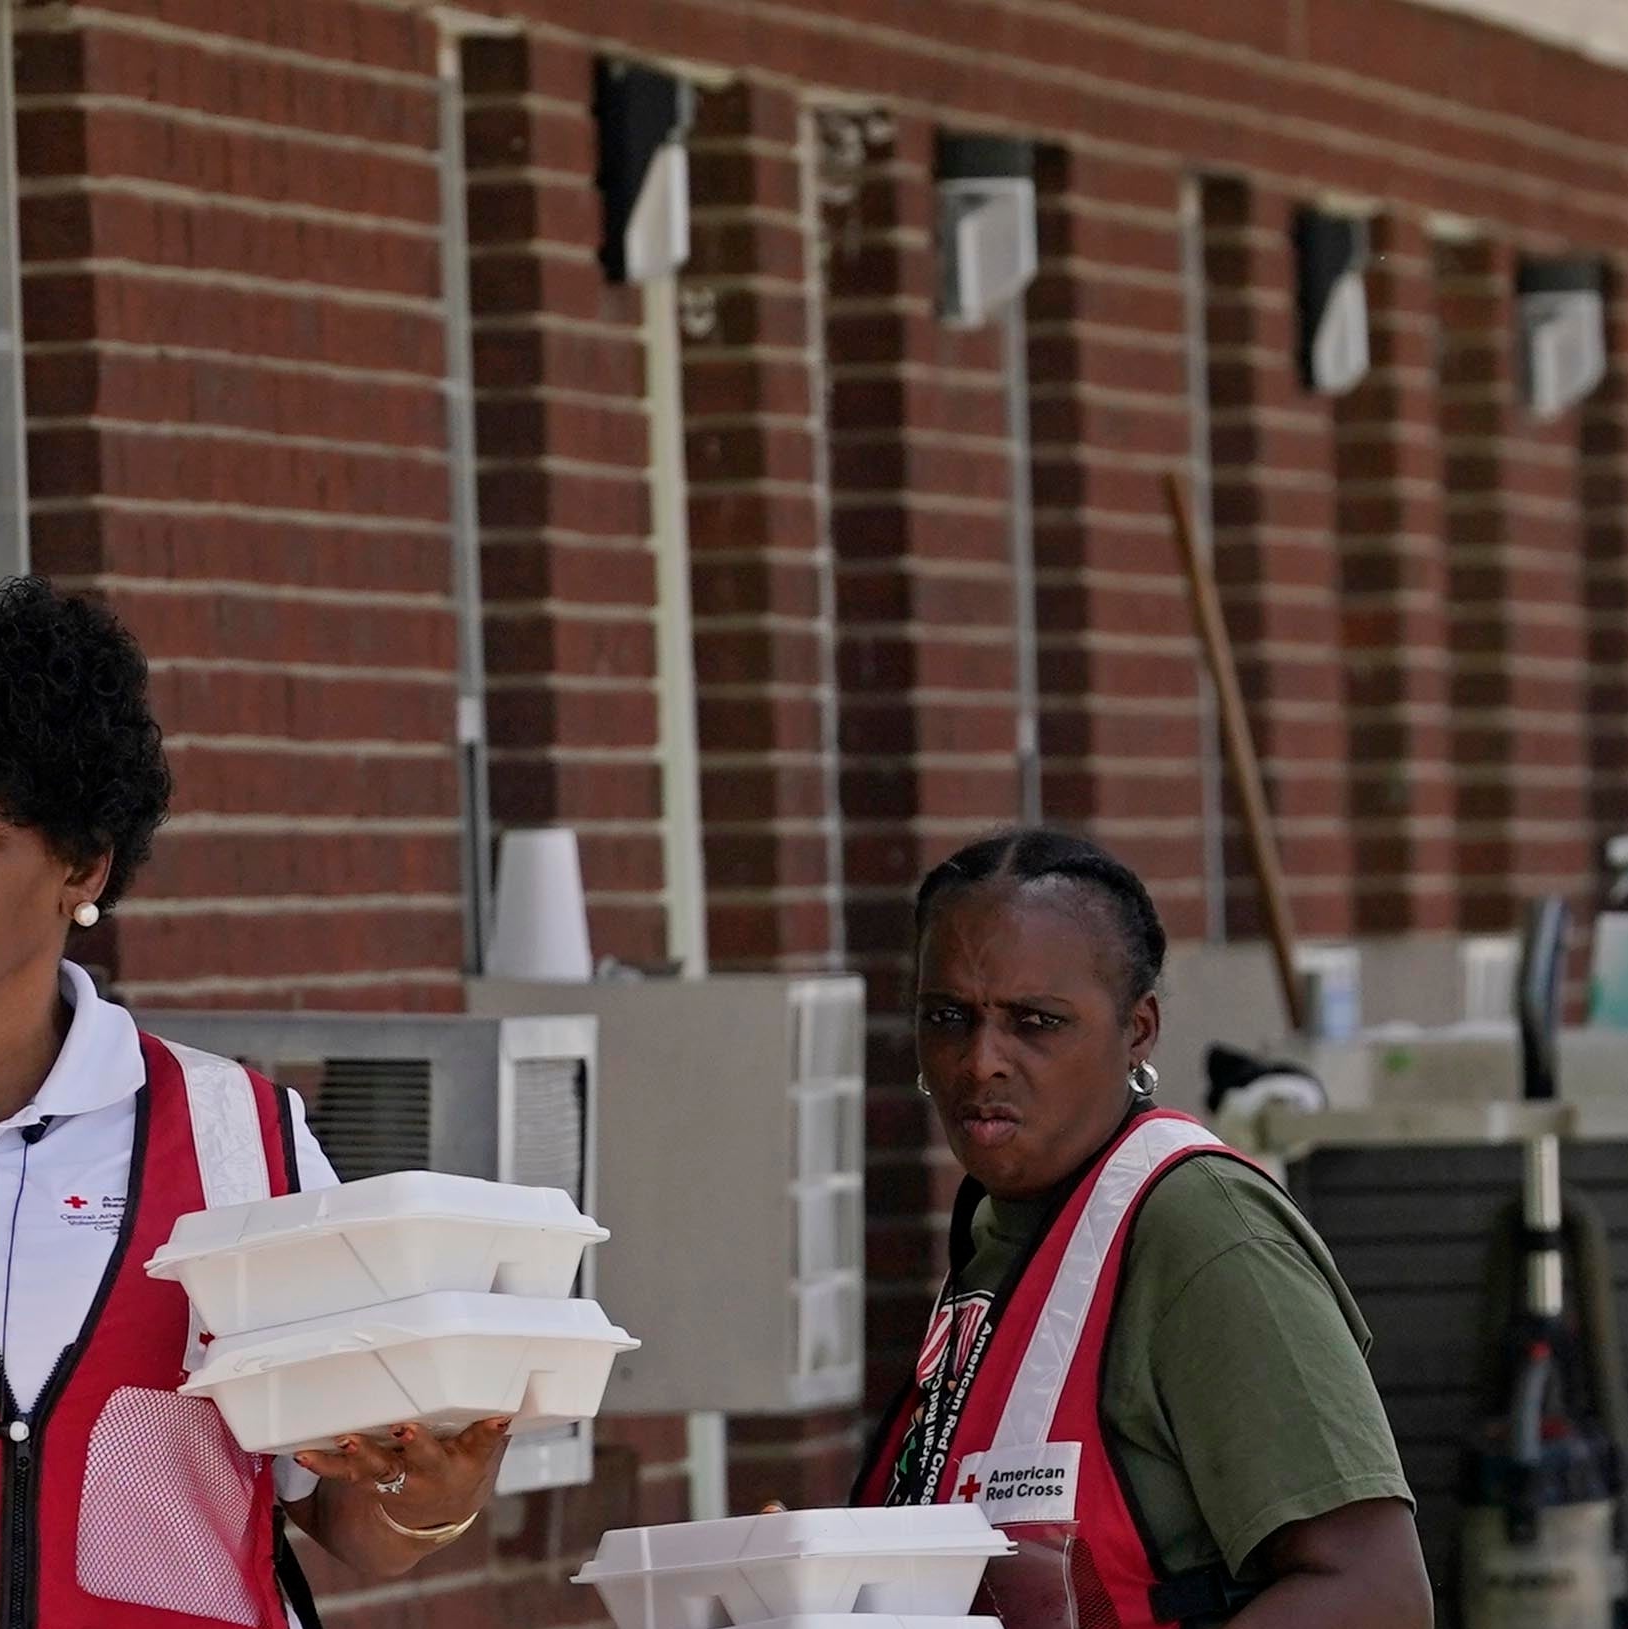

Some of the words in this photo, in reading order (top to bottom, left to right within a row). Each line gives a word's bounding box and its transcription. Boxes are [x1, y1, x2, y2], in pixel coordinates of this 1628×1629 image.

[952, 1321, 993, 1411] American
[937, 1412, 958, 1452] Red
[920, 1452, 946, 1505] Cross
[986, 1484, 1013, 1501] Red
[1017, 1483, 1063, 1498] Cross
[989, 1466, 1065, 1484] American
